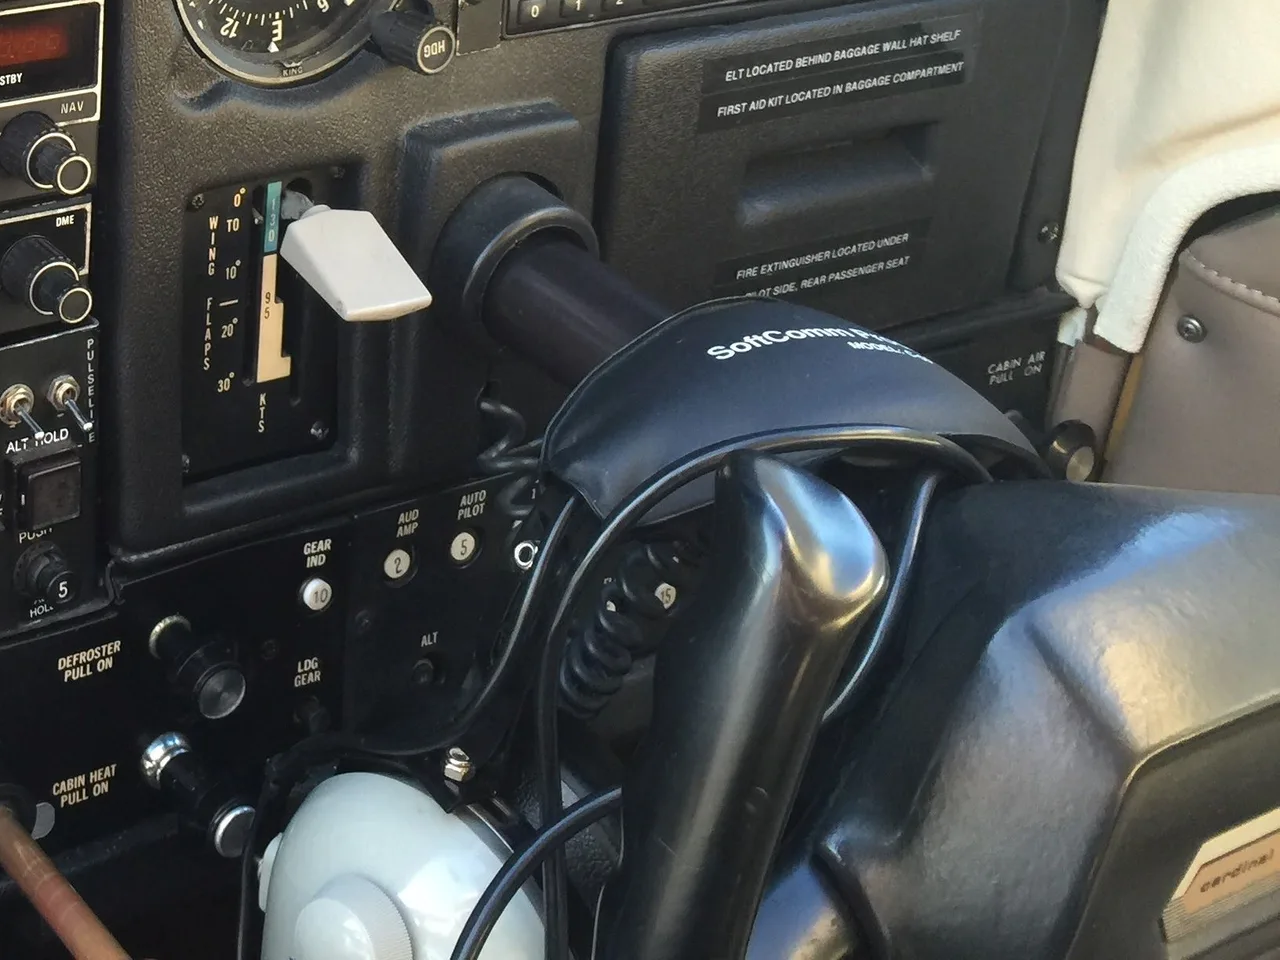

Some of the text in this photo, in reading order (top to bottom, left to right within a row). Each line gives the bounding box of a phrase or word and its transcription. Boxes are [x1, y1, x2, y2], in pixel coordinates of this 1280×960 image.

[725, 29, 962, 82] ELT LOCATED BEHIND BAGGAGE WALL HAT SHELF
[0, 72, 23, 86] STBY
[717, 61, 964, 118] FIRST AID KIT LOCATED IN BAGGAGE COMPARTMENT
[60, 101, 84, 114] NAV
[55, 214, 75, 228] DME
[736, 232, 909, 280] FIRE EXTINGUISHER LOCATED UNDER
[800, 255, 910, 290] REAR PASSENGER SEAT
[707, 327, 855, 360] SoftComm
[987, 351, 1045, 374] CABIN AIR
[460, 489, 487, 506] AUTO
[398, 509, 419, 525] AUD
[457, 503, 486, 520] PILOT
[396, 521, 419, 538] AMP
[303, 538, 331, 556] GEAR
[306, 554, 326, 568] IND
[57, 639, 121, 671] DEFROSTER
[63, 656, 113, 683] PULL ON
[297, 656, 319, 673] LDG
[294, 670, 321, 688] GEAR
[52, 763, 117, 797] CABIN HEAT
[59, 781, 109, 808] PULL ON
